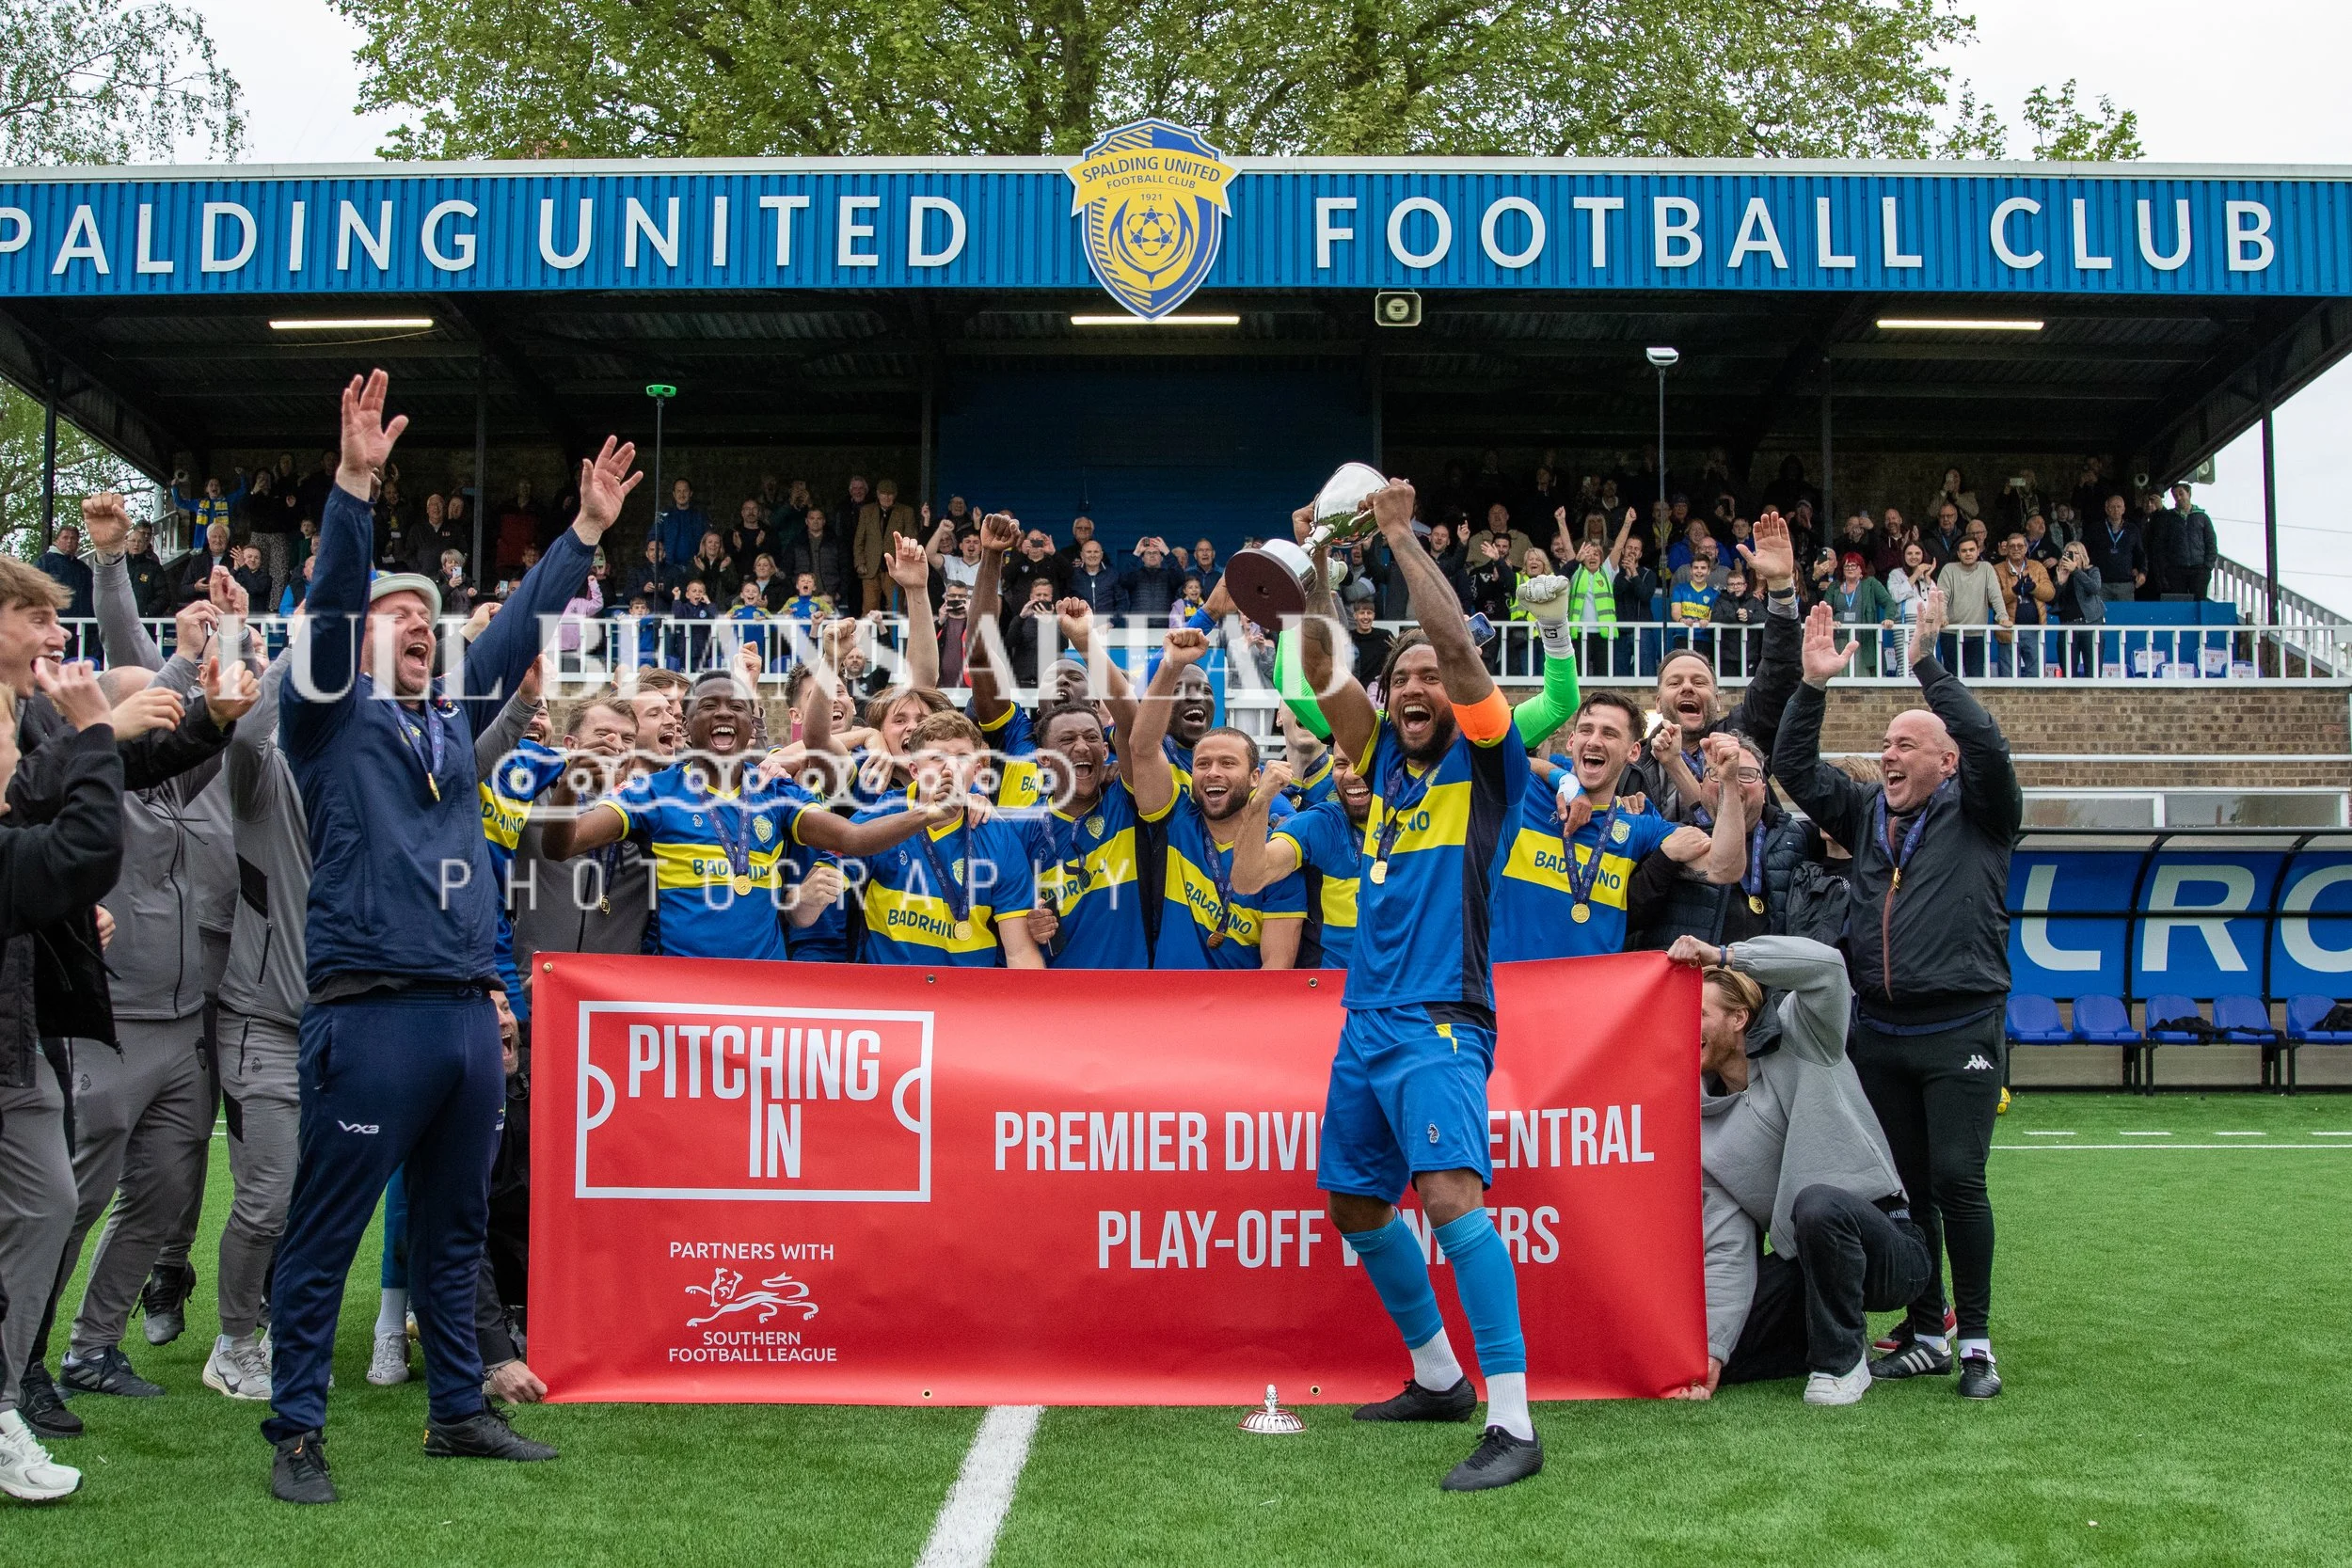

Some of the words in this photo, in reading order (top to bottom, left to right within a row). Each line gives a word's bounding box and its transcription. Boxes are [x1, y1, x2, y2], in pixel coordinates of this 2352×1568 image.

[1082, 156, 1159, 183] SPALDING
[1164, 156, 1221, 182] UNITED
[1106, 174, 1164, 189] FOOTBALL
[1168, 175, 1196, 188] CLUB
[1141, 193, 1163, 201] 1921
[0, 199, 478, 275] PALDING
[538, 195, 966, 270] UNITED
[1316, 196, 1923, 269] FOOTBALL
[1989, 197, 2276, 272] CLUB
[628, 1024, 881, 1101] PITCHING
[338, 1120, 380, 1134] VX3
[994, 1111, 1209, 1171] PREMIER
[1225, 1111, 1327, 1171] DIVI
[1487, 1104, 1655, 1169] ENTRAL
[749, 1103, 802, 1179] IN
[670, 1242, 775, 1259] PARTNERS
[781, 1243, 834, 1260] WITH
[1098, 1210, 1326, 1269] PLAY-OFF
[703, 1331, 801, 1346] SOUTHERN
[669, 1348, 763, 1362] FOOTBALL
[768, 1348, 837, 1362] LEAGUE
